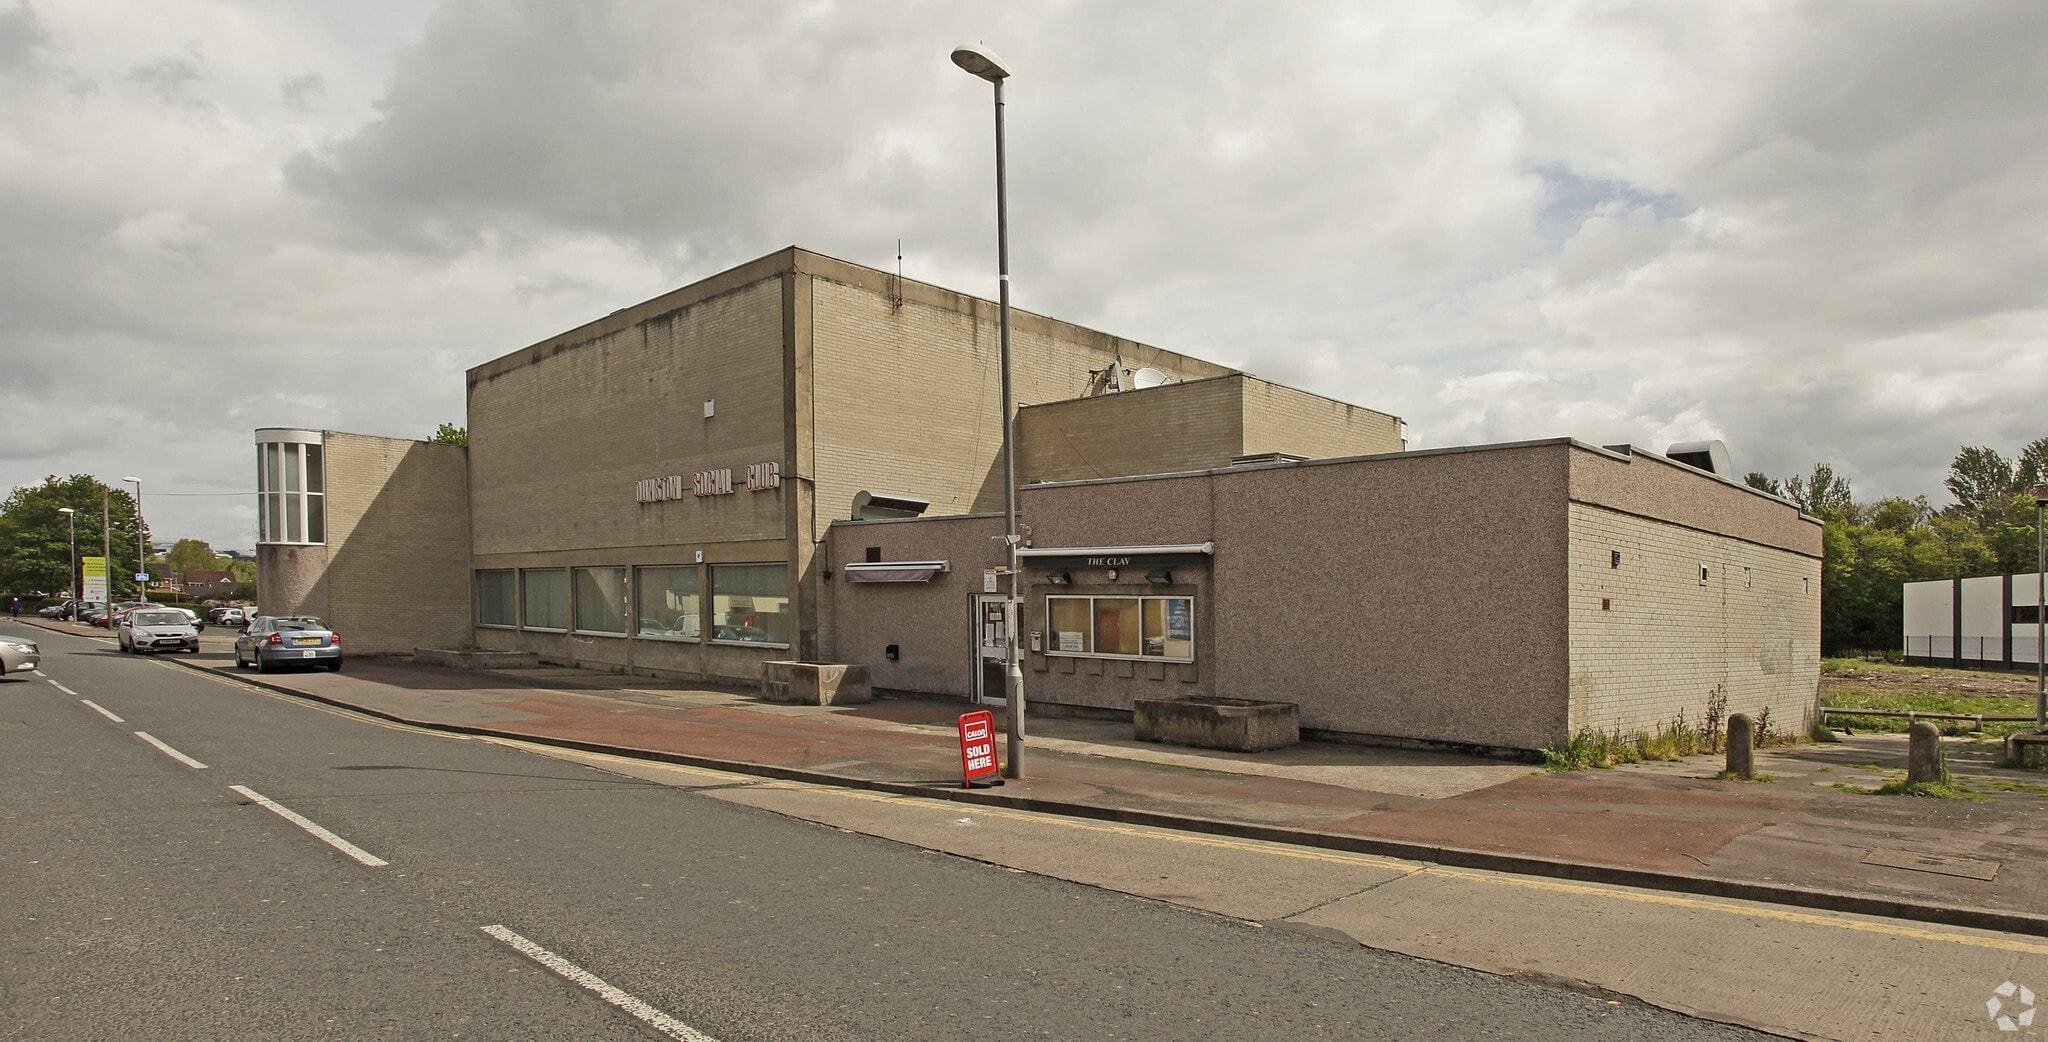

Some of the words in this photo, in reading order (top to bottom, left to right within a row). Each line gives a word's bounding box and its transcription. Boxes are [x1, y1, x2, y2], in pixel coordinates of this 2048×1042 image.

[635, 475, 682, 503] DUNSTON
[692, 468, 734, 497] SOCIAL
[745, 461, 780, 491] CLUB
[1087, 557, 1104, 566] THE
[966, 744, 990, 758] SOLD
[968, 756, 992, 771] HERE
